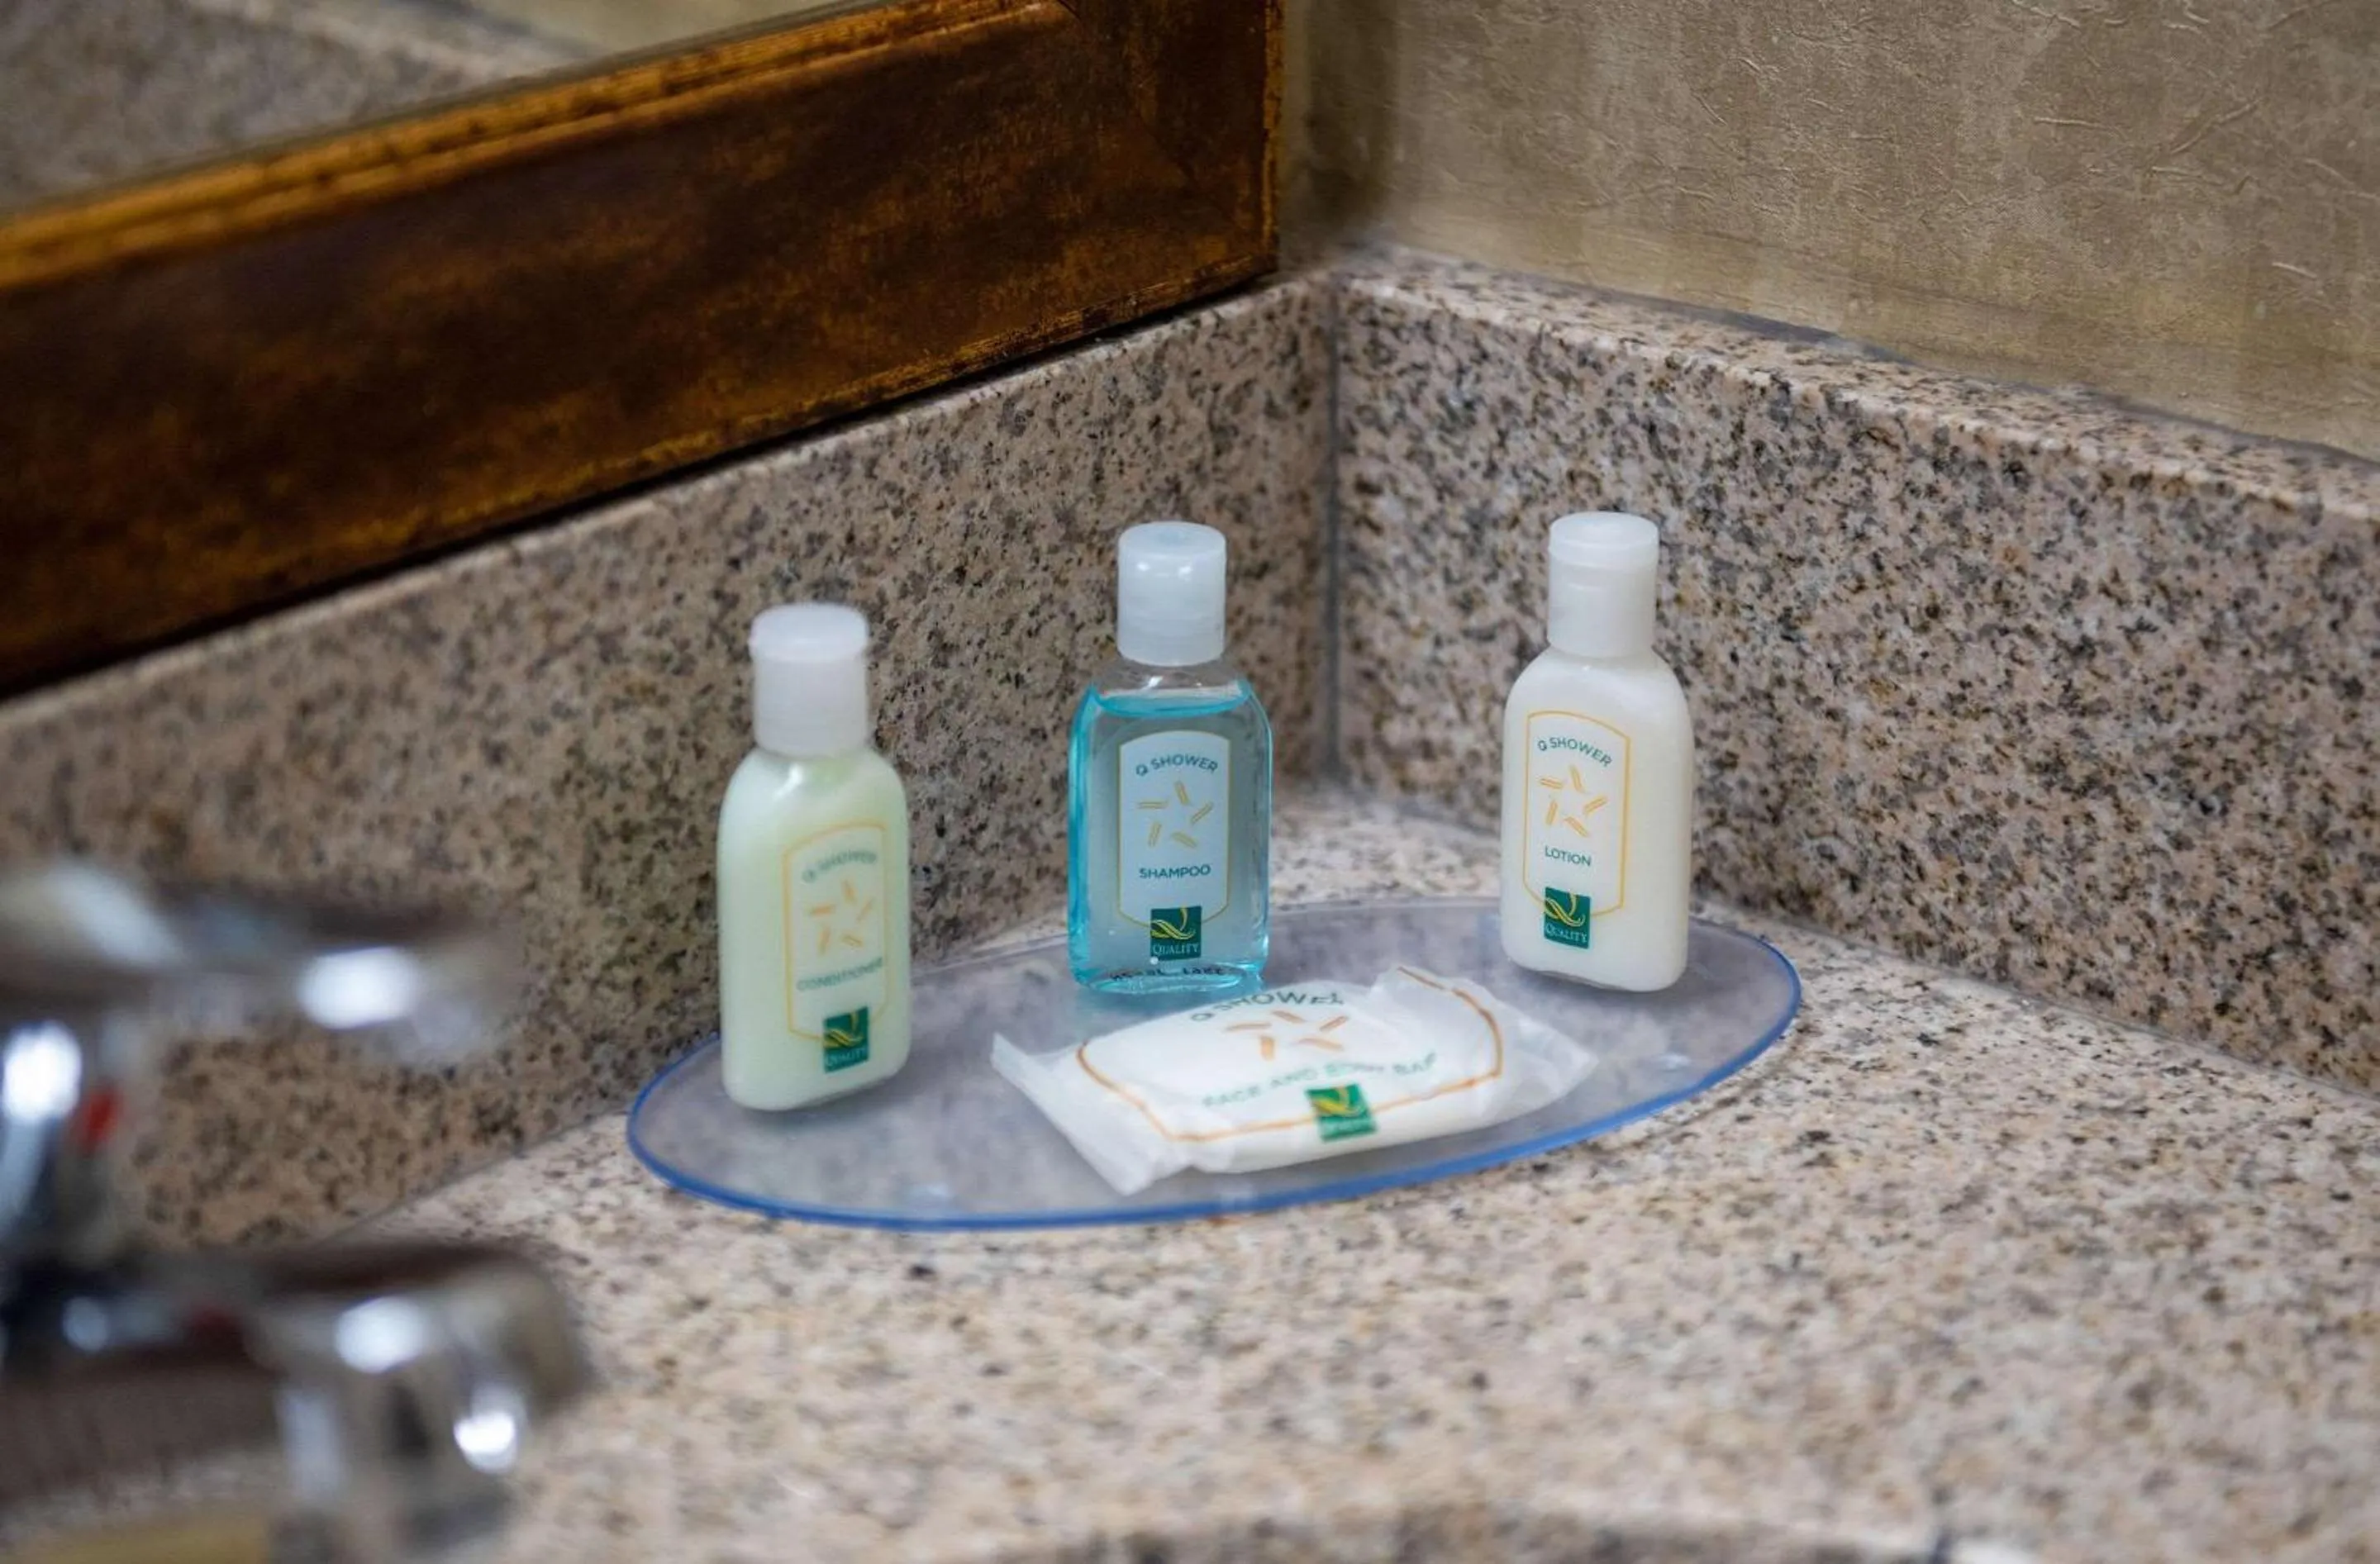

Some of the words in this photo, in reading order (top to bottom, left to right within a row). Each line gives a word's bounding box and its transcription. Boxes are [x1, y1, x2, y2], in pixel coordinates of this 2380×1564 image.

[1538, 740, 1548, 752] Q
[1549, 737, 1612, 768] SHOWER
[1135, 763, 1150, 777] Q
[1150, 753, 1219, 772] SHOWER
[1545, 845, 1592, 867] LOTION
[1139, 864, 1211, 879] SHAMPOO
[1546, 922, 1587, 944] QUALITY
[1153, 942, 1199, 957] QUALITY
